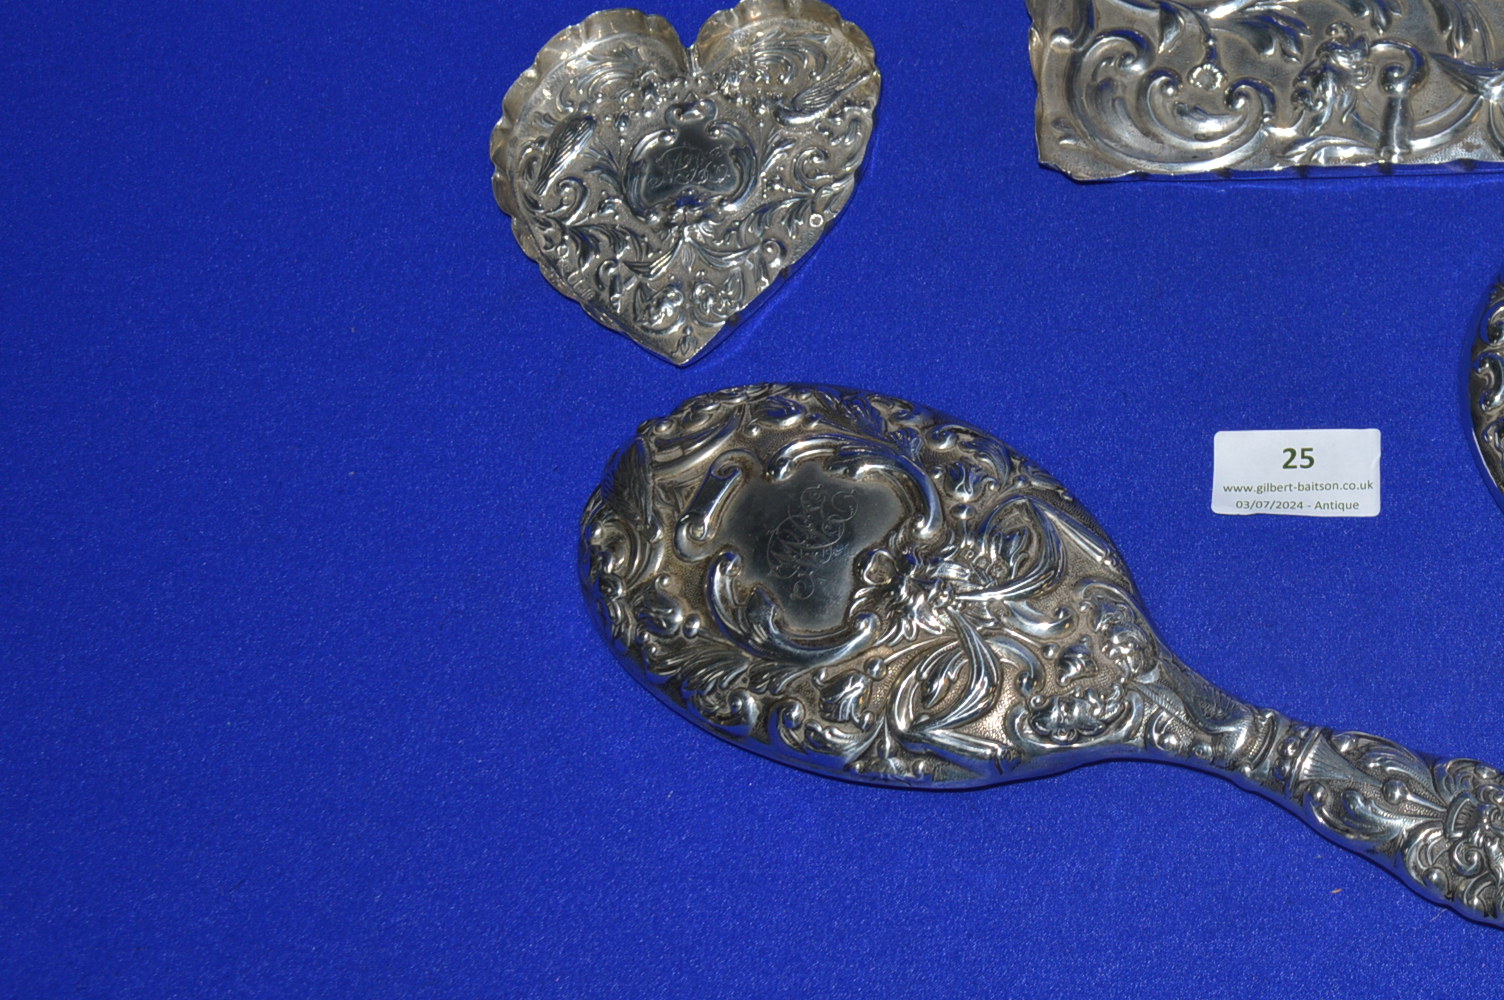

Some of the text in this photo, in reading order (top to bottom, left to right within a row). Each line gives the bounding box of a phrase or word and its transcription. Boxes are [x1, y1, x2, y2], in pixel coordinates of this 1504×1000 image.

[1282, 447, 1315, 469] 25
[1223, 480, 1374, 495] www.gilbert-baitson.co.uk
[1235, 500, 1304, 510] 03/07/2024
[1314, 500, 1360, 512] Antique
